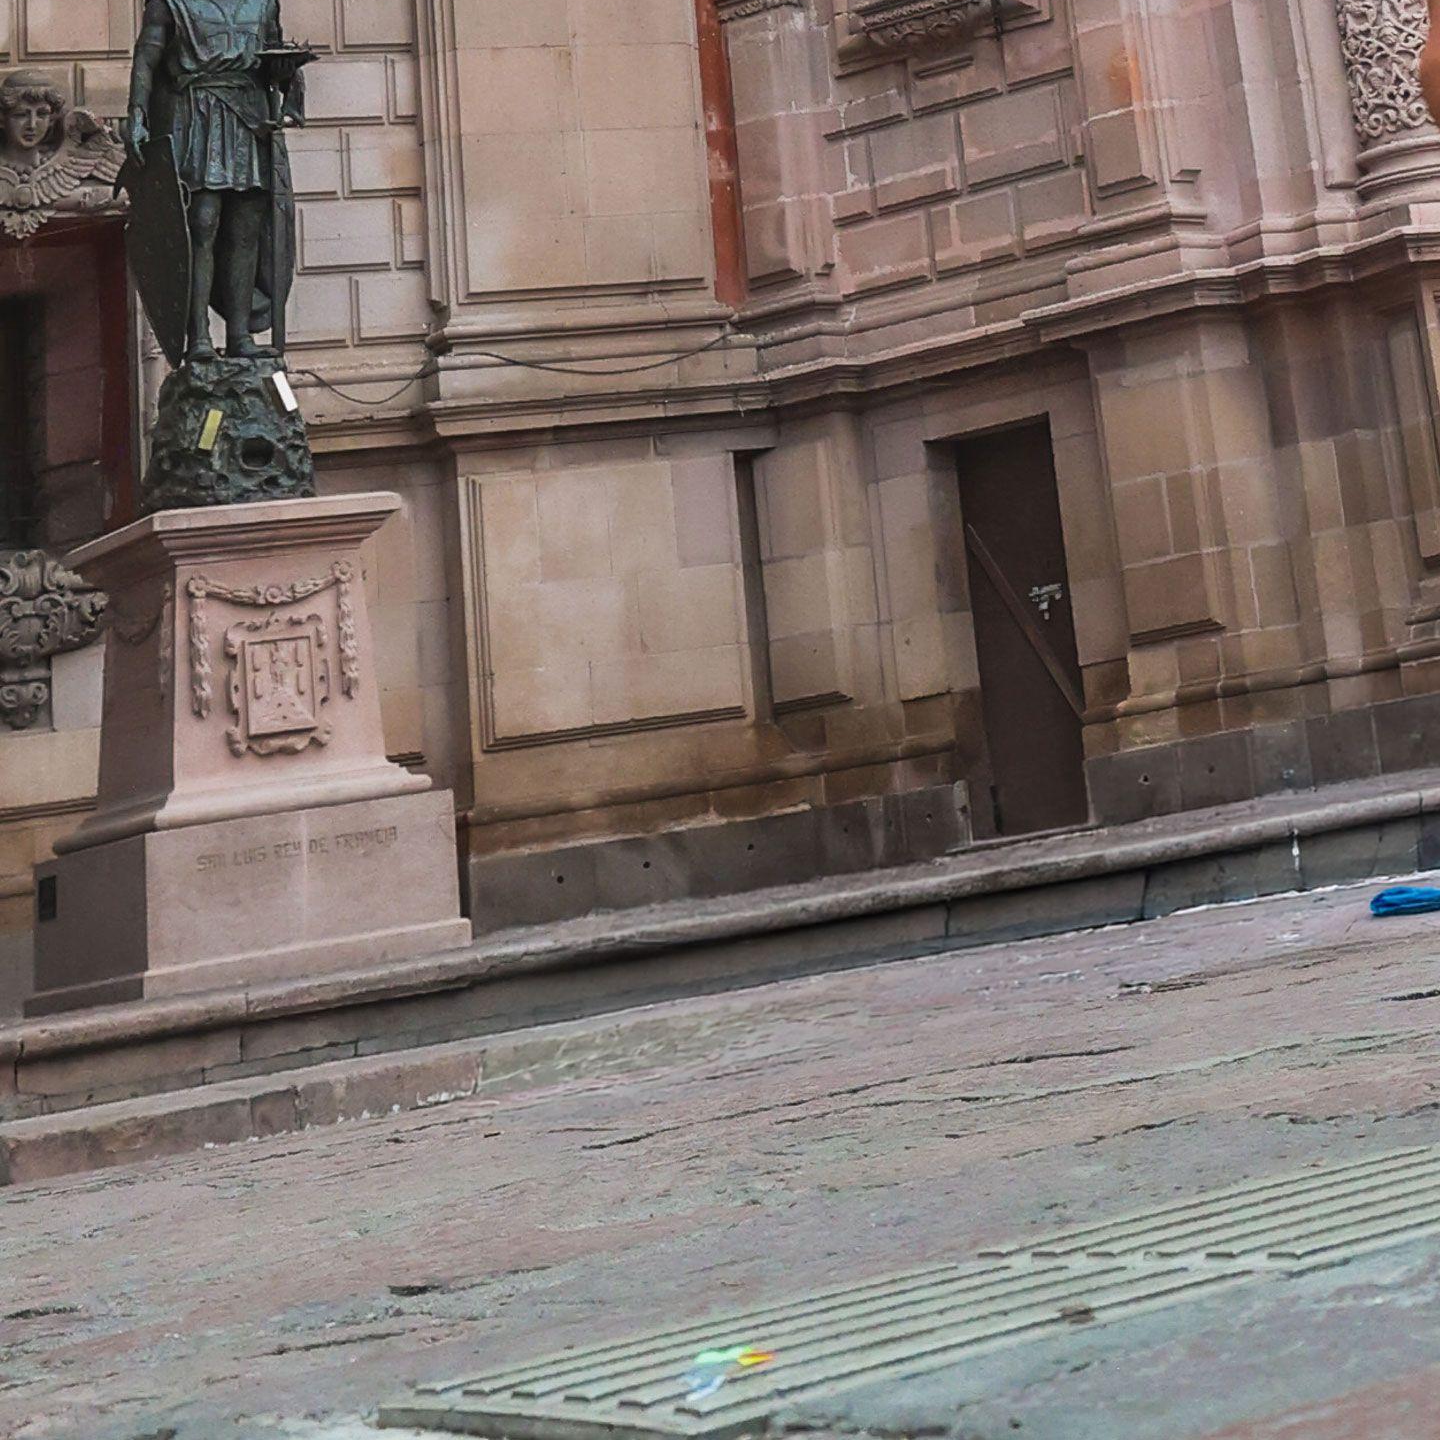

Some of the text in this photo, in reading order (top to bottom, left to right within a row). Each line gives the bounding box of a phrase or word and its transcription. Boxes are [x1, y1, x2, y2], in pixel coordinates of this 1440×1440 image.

[196, 825, 398, 873] SAN LUIS REY DE FRANCIA
